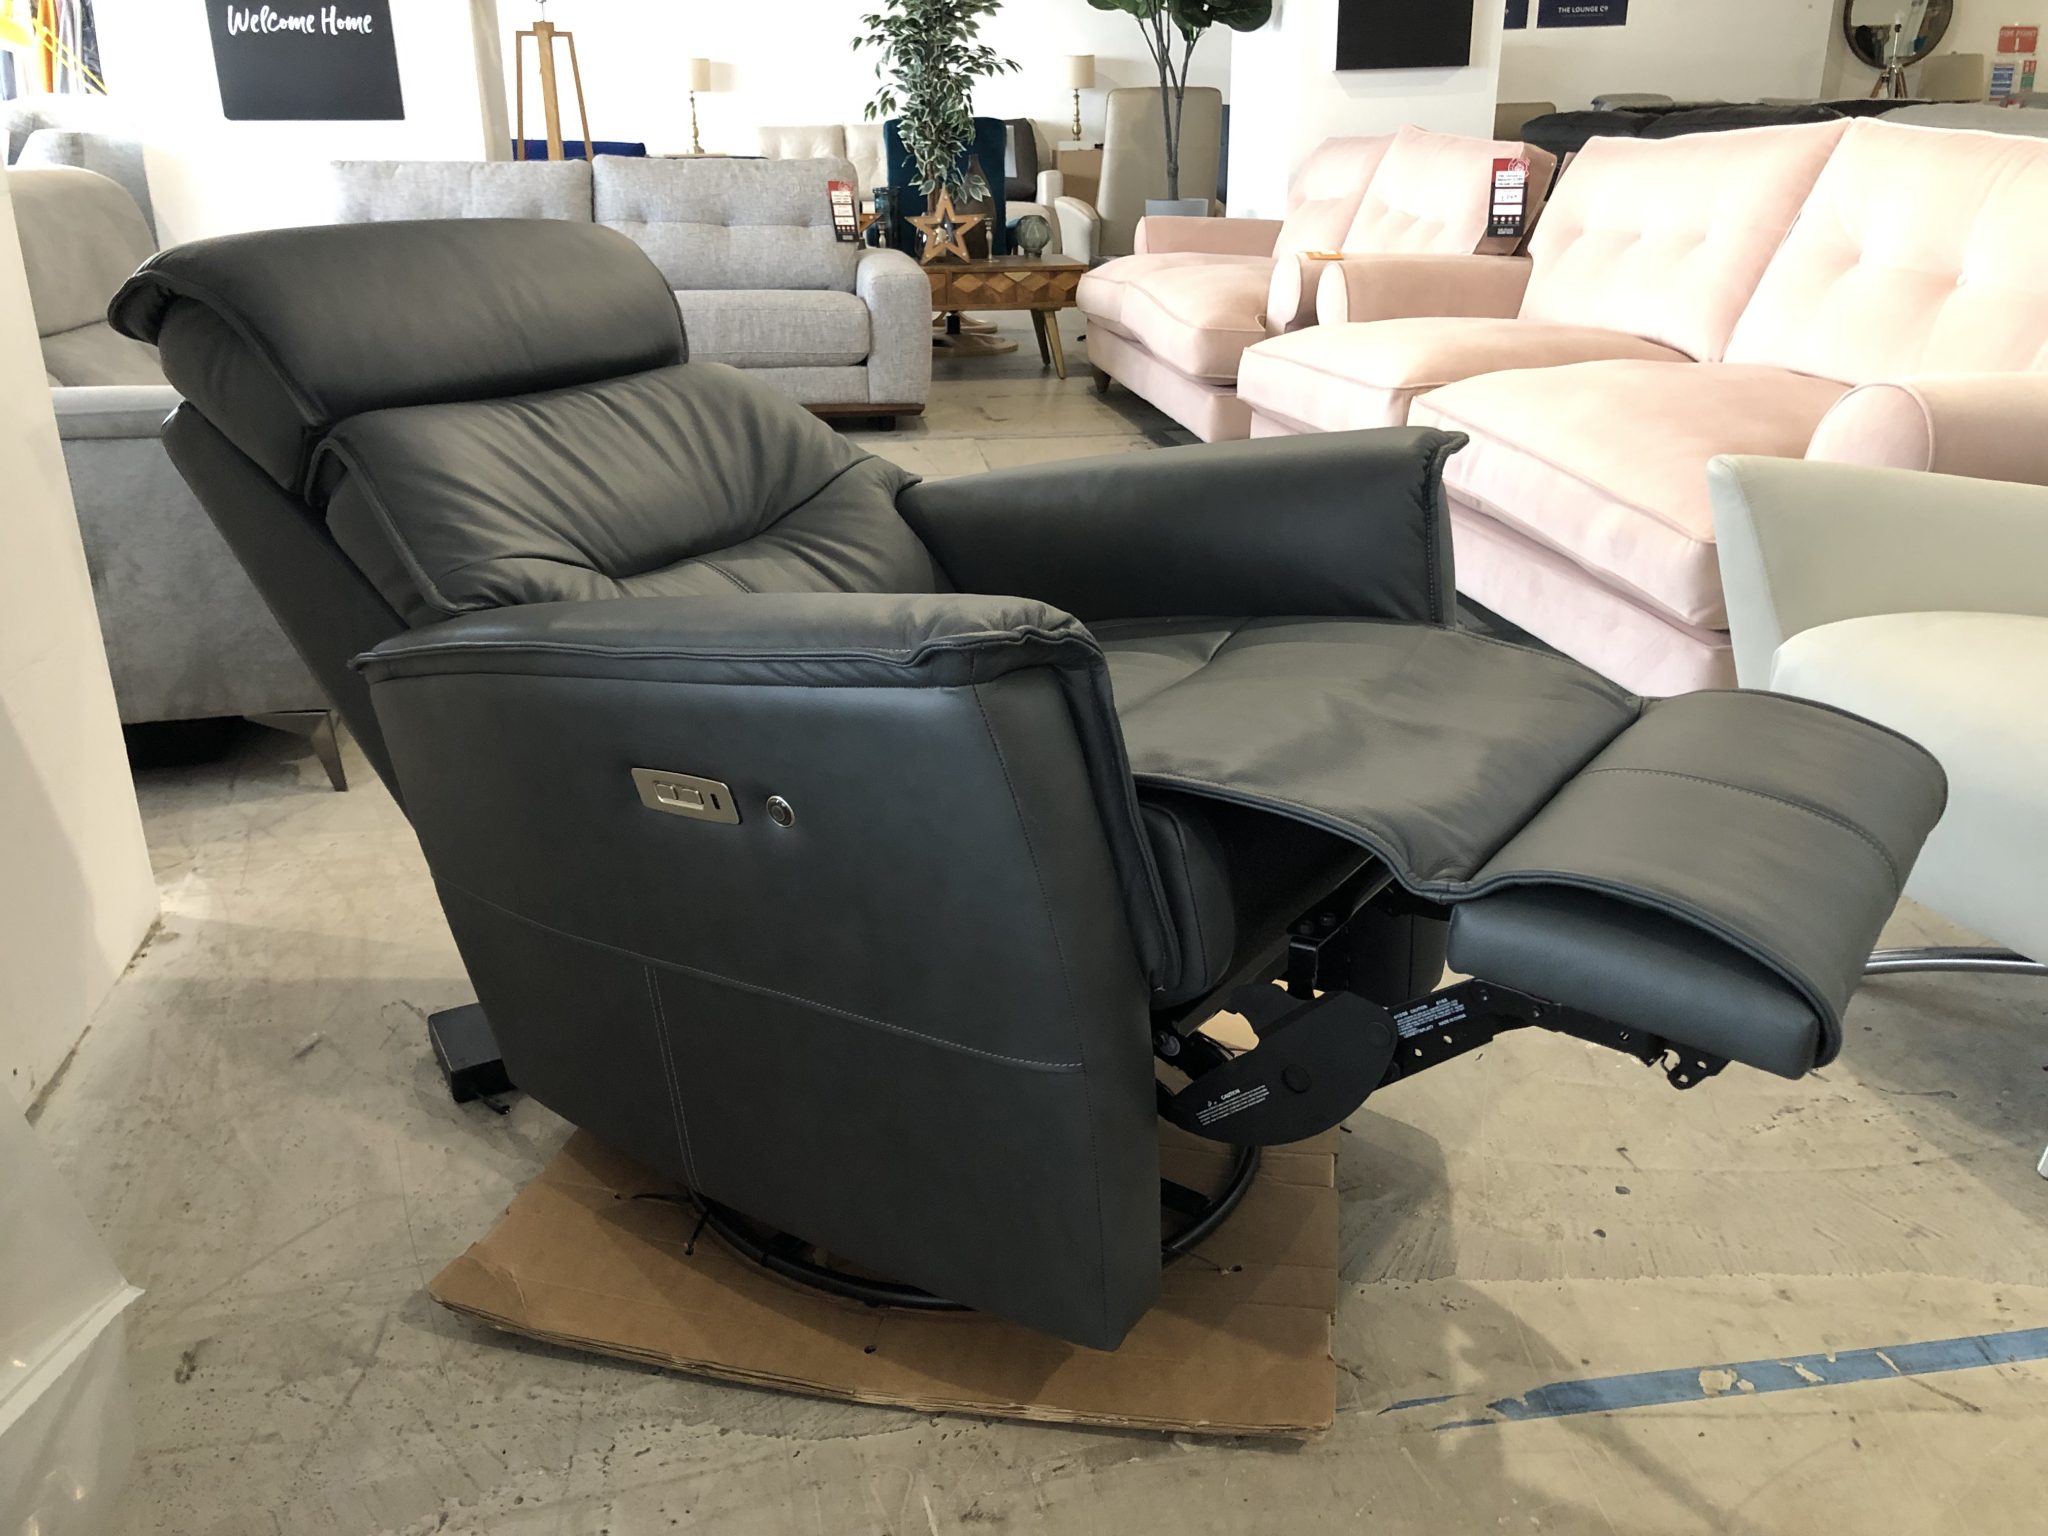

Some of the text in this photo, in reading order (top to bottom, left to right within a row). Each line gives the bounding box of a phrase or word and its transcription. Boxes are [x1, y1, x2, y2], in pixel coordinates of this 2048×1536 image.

[1558, 6, 1571, 14] THE
[227, 5, 373, 35] Welcome Home
